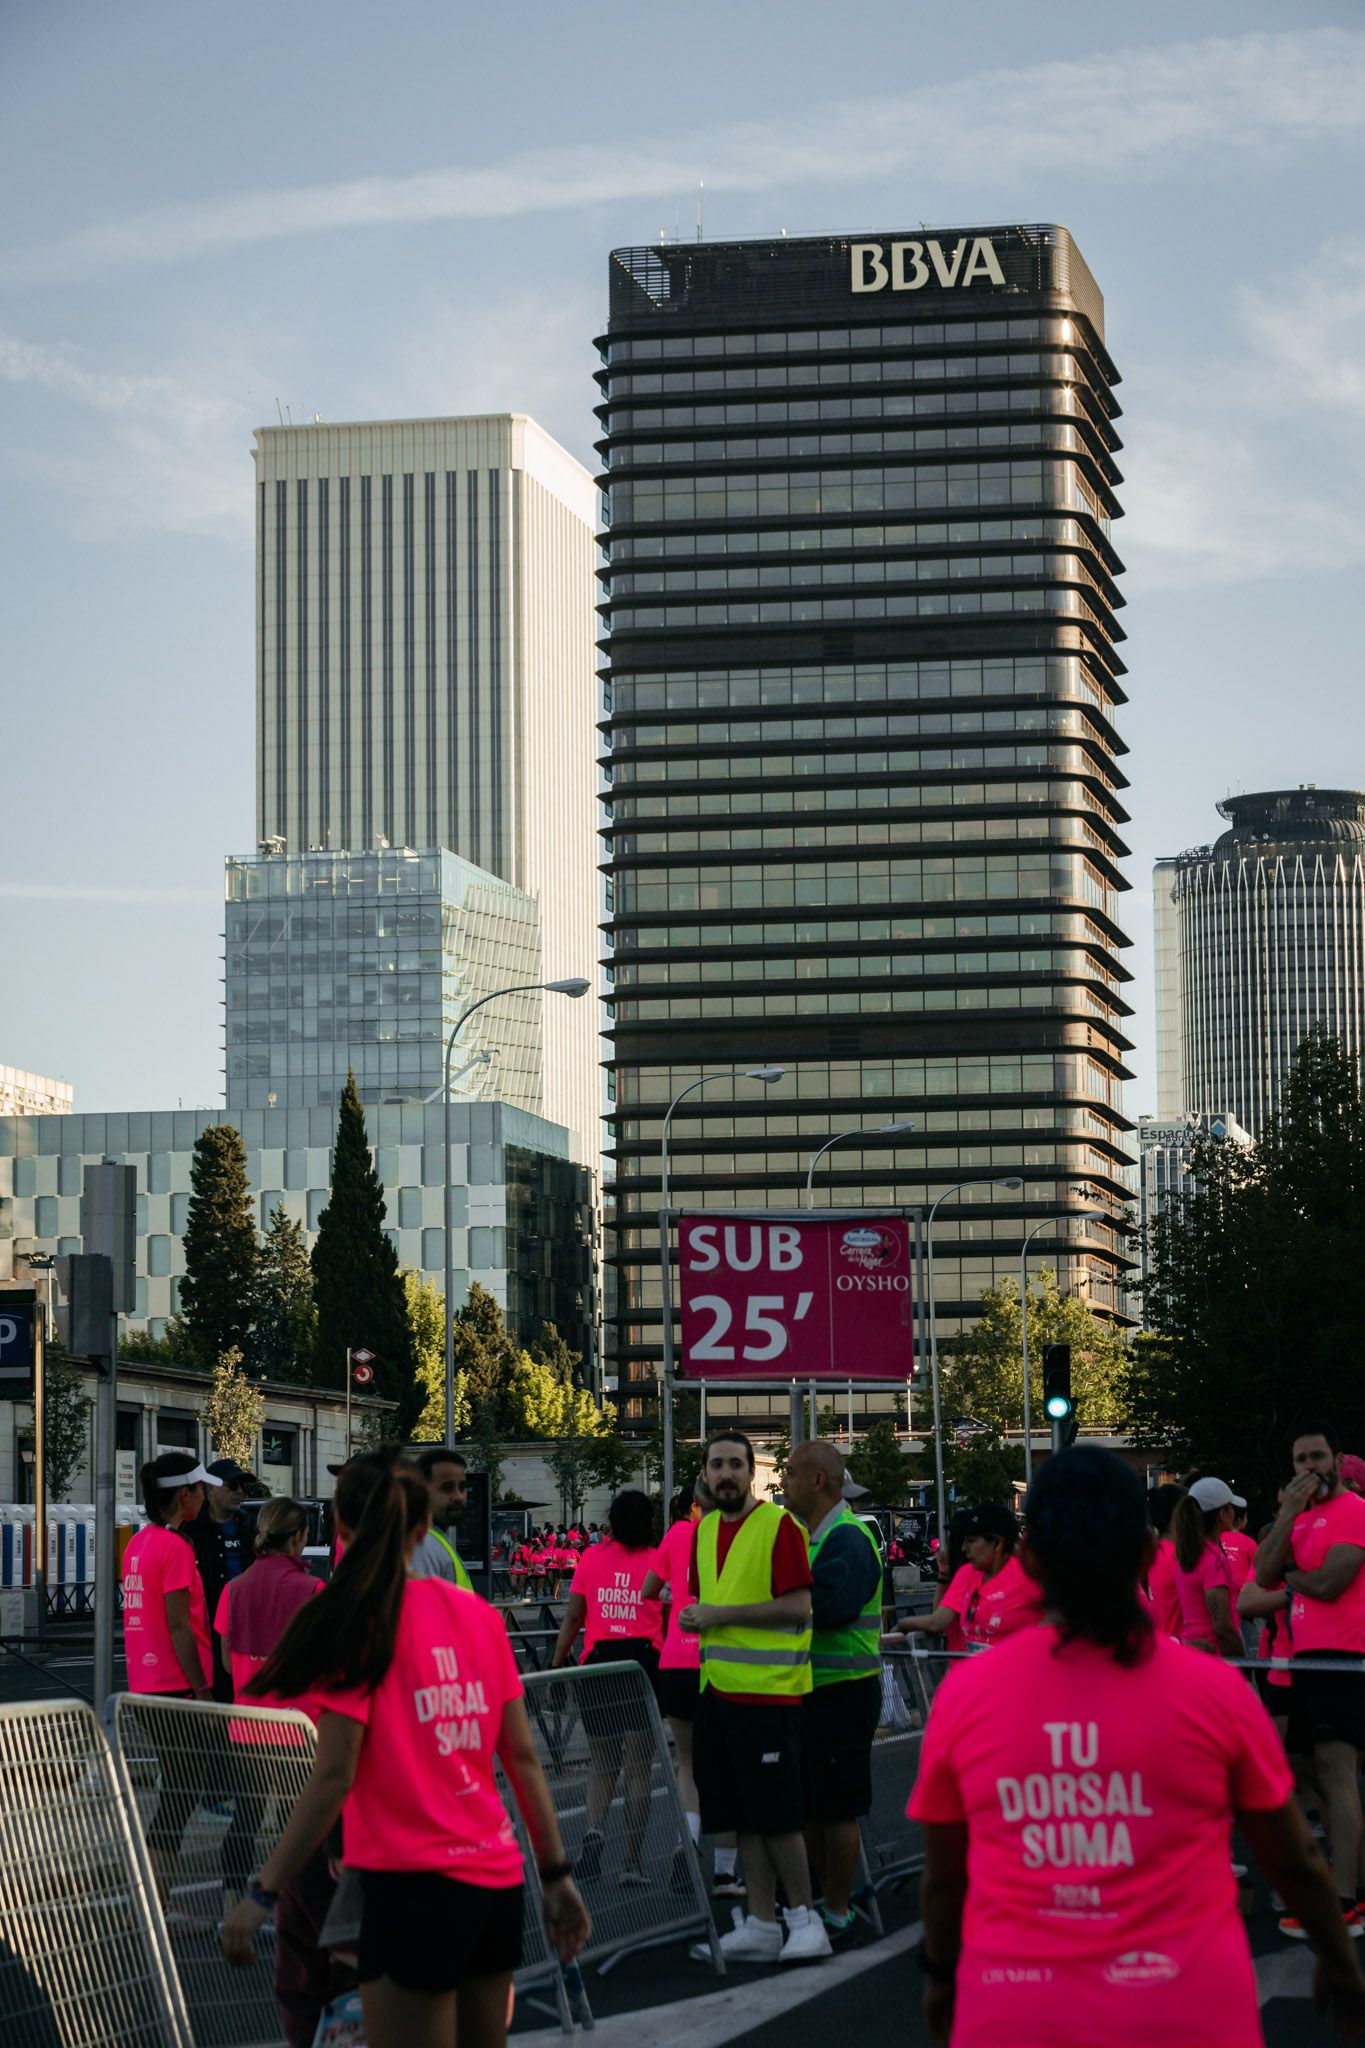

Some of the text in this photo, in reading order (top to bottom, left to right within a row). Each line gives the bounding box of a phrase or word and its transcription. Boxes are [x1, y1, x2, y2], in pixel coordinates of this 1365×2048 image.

[851, 237, 1006, 293] BBVA
[1140, 1127, 1196, 1142] Espacio
[688, 1225, 804, 1272] SUB
[836, 1274, 909, 1292] OYSHO
[688, 1292, 814, 1361] 25'
[597, 1587, 644, 1605] DORSAL
[614, 1572, 631, 1588] TU
[601, 1604, 637, 1620] SUMA
[431, 1646, 459, 1681] TU
[434, 1717, 481, 1756] SMA
[1043, 1722, 1098, 1768] TU
[996, 1771, 1153, 1822] DORSAL
[1021, 1821, 1135, 1868] SUMA
